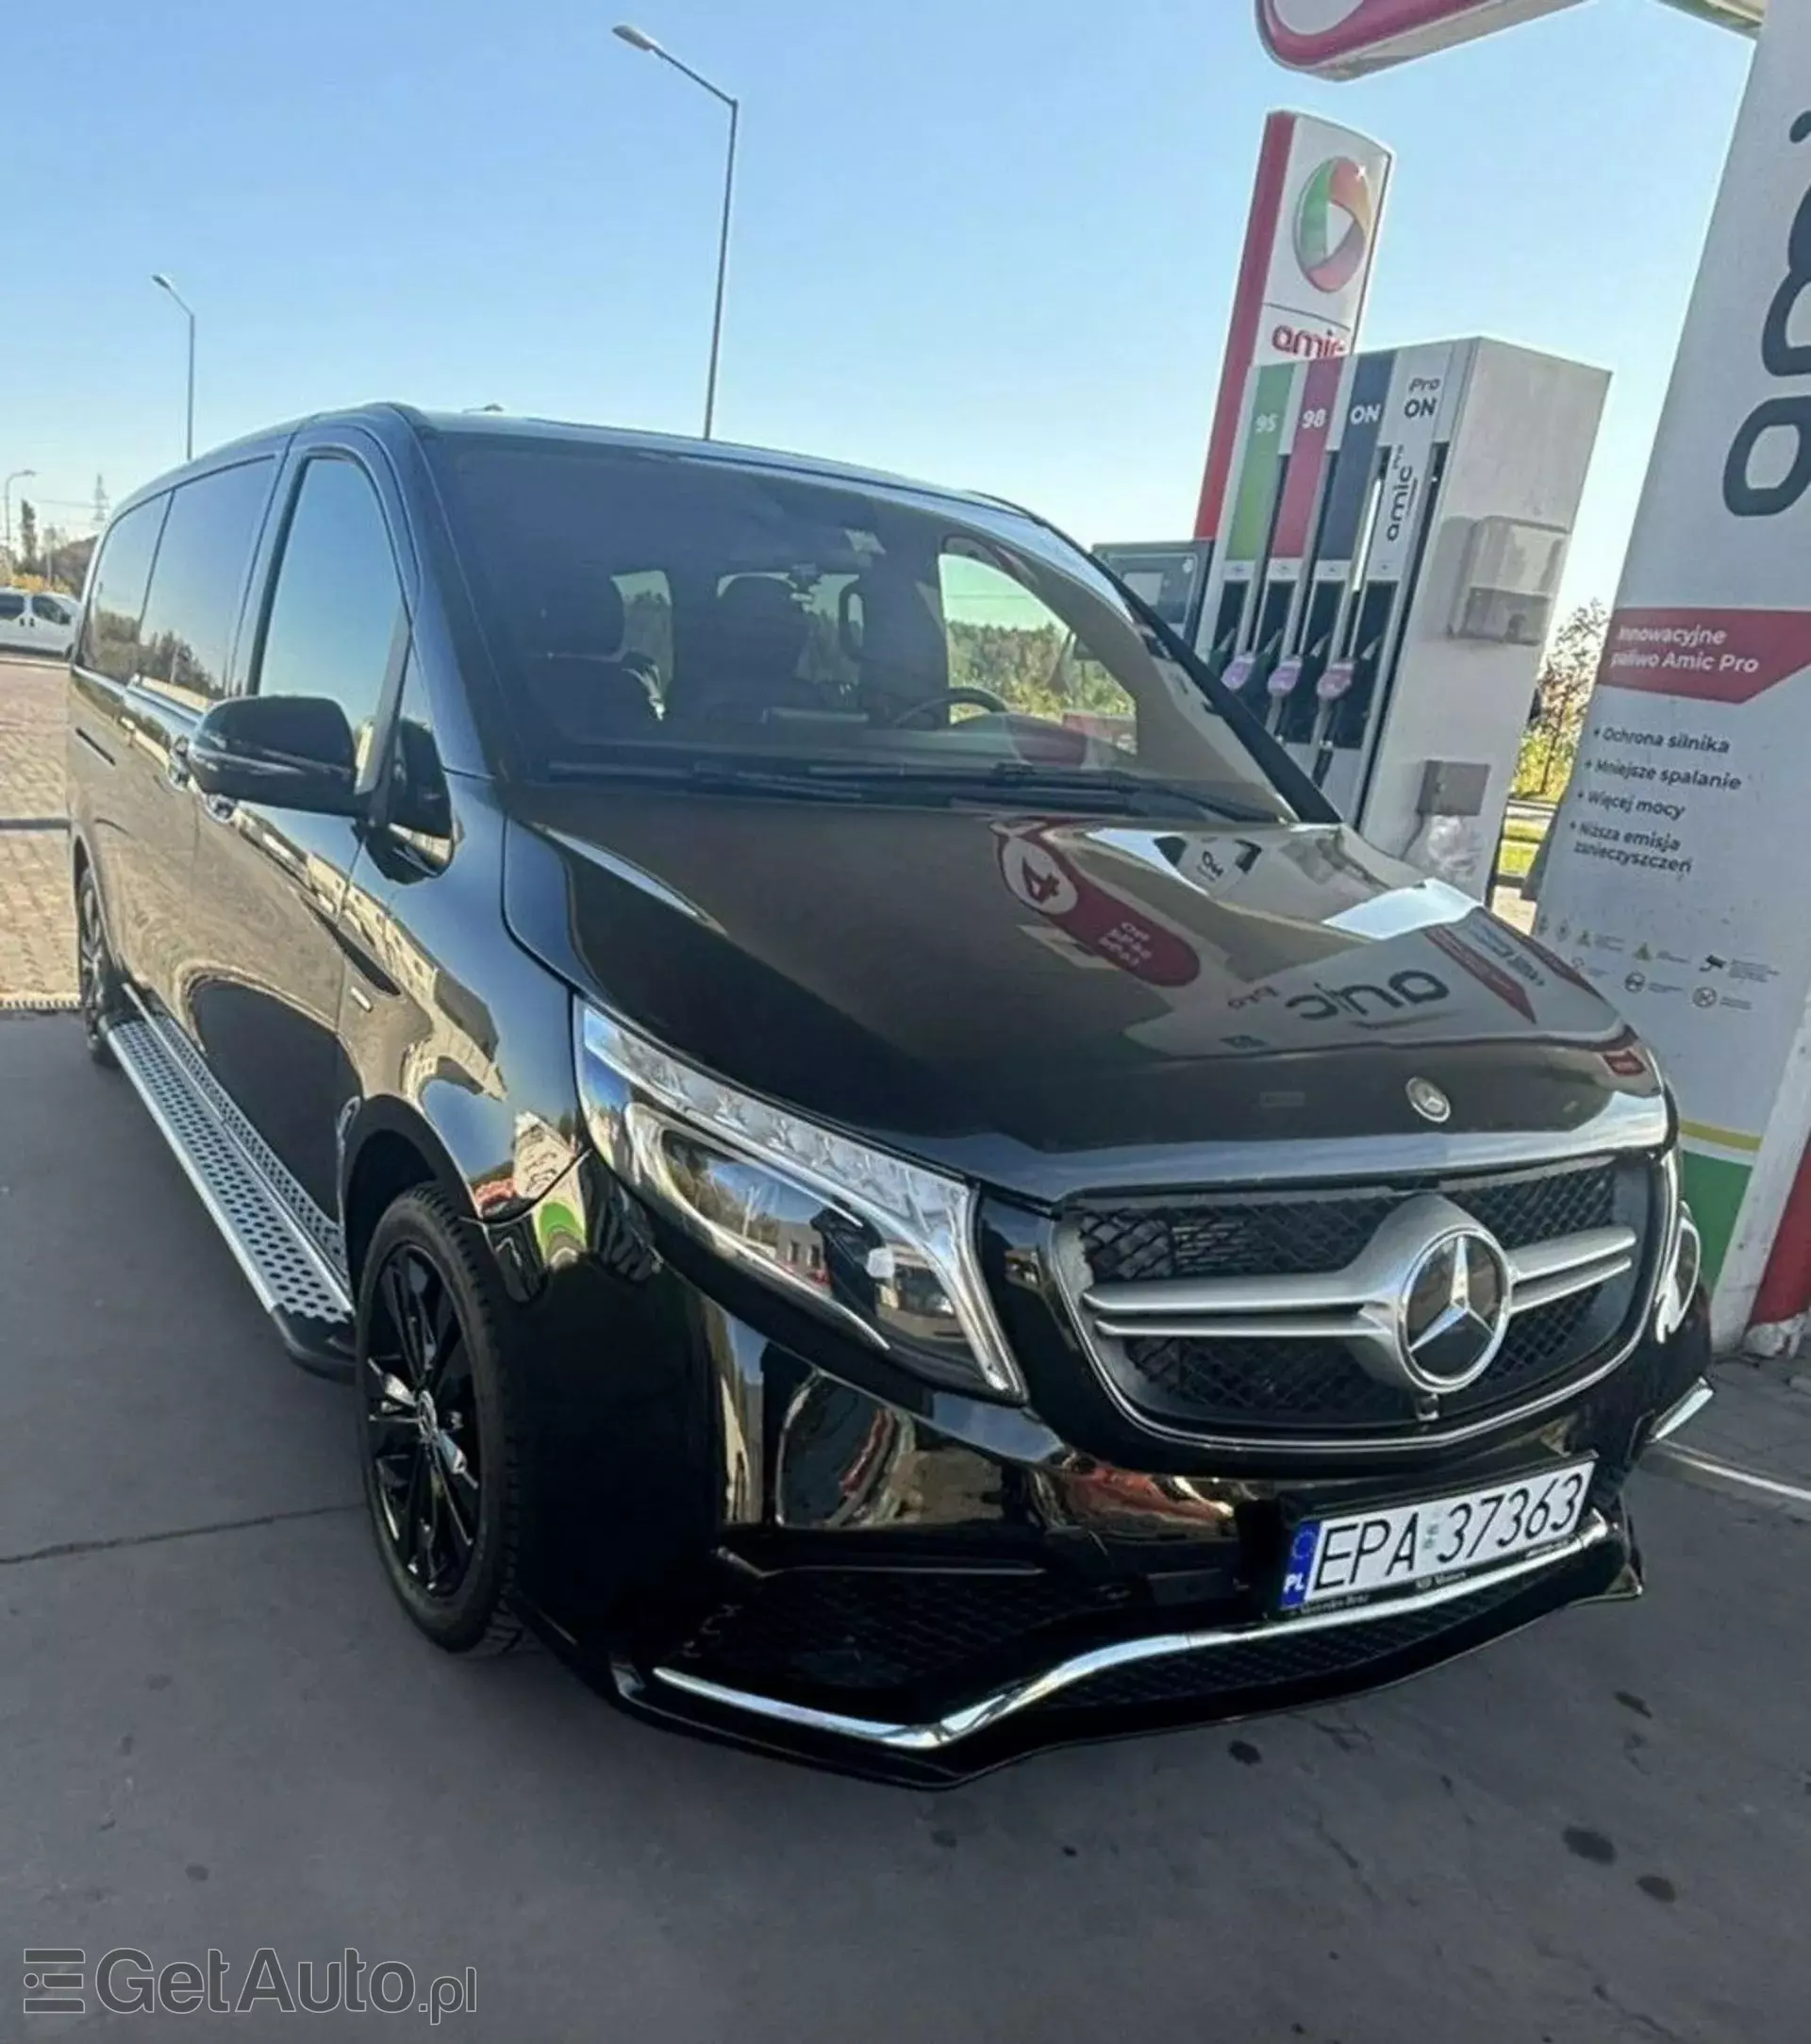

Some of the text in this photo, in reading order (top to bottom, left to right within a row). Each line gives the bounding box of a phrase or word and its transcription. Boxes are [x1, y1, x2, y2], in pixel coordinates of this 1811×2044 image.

[1350, 405, 1381, 424] ON
[1404, 398, 1437, 418] ON
[1254, 414, 1279, 435] 95
[1302, 409, 1326, 429] 98
[1387, 466, 1414, 541] amic
[1661, 652, 1714, 672] Amic
[1719, 653, 1759, 673] Pro
[1603, 726, 1731, 754] Ochrona silnika
[1658, 769, 1742, 790] spalanie
[1636, 798, 1686, 822] mocy
[1622, 830, 1682, 854] emisja
[1314, 1472, 1585, 1591] EPA 37363
[1283, 1573, 1305, 1594] PL
